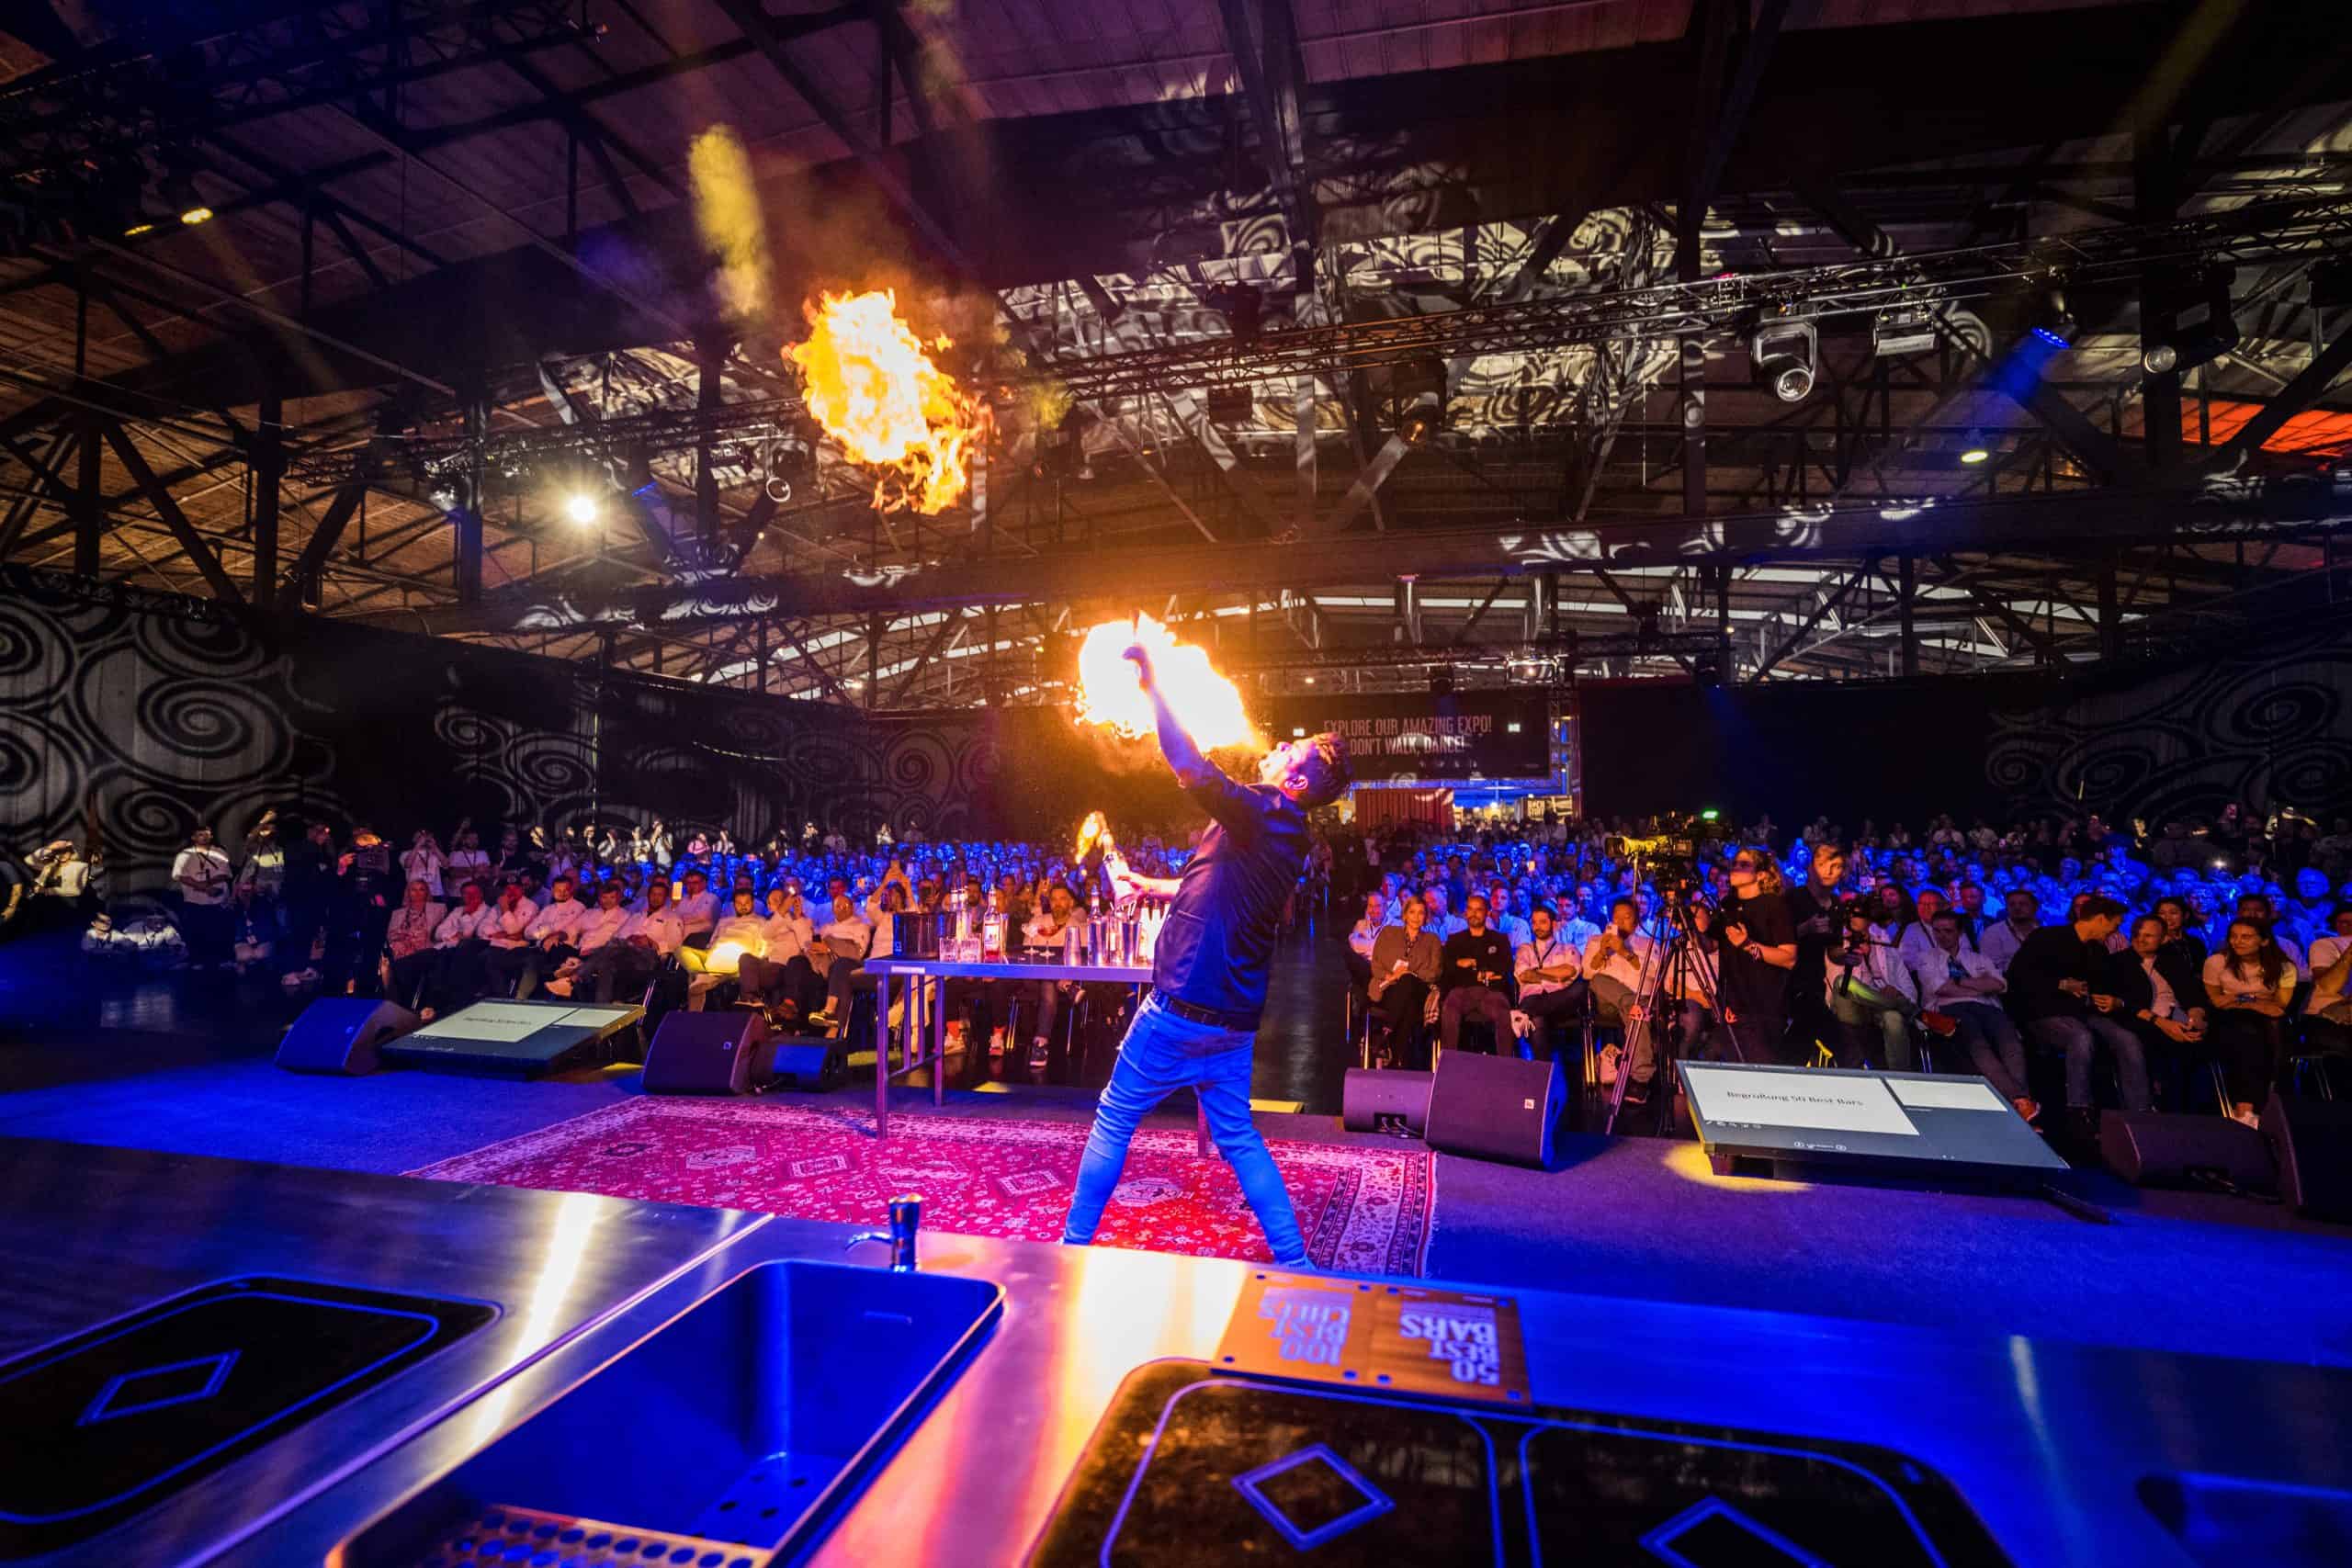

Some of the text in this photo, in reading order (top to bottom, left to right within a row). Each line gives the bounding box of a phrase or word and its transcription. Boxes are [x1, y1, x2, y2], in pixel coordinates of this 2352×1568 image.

[1324, 715, 1493, 736] EXPLORE OUR AMAZING EXPO!
[1350, 735, 1466, 756] DON'T WALK, DANCE!
[1399, 1314, 1498, 1346] BARS
[1279, 1335, 1342, 1367] 100
[1429, 1338, 1499, 1366] BEST
[1451, 1358, 1500, 1386] 50
